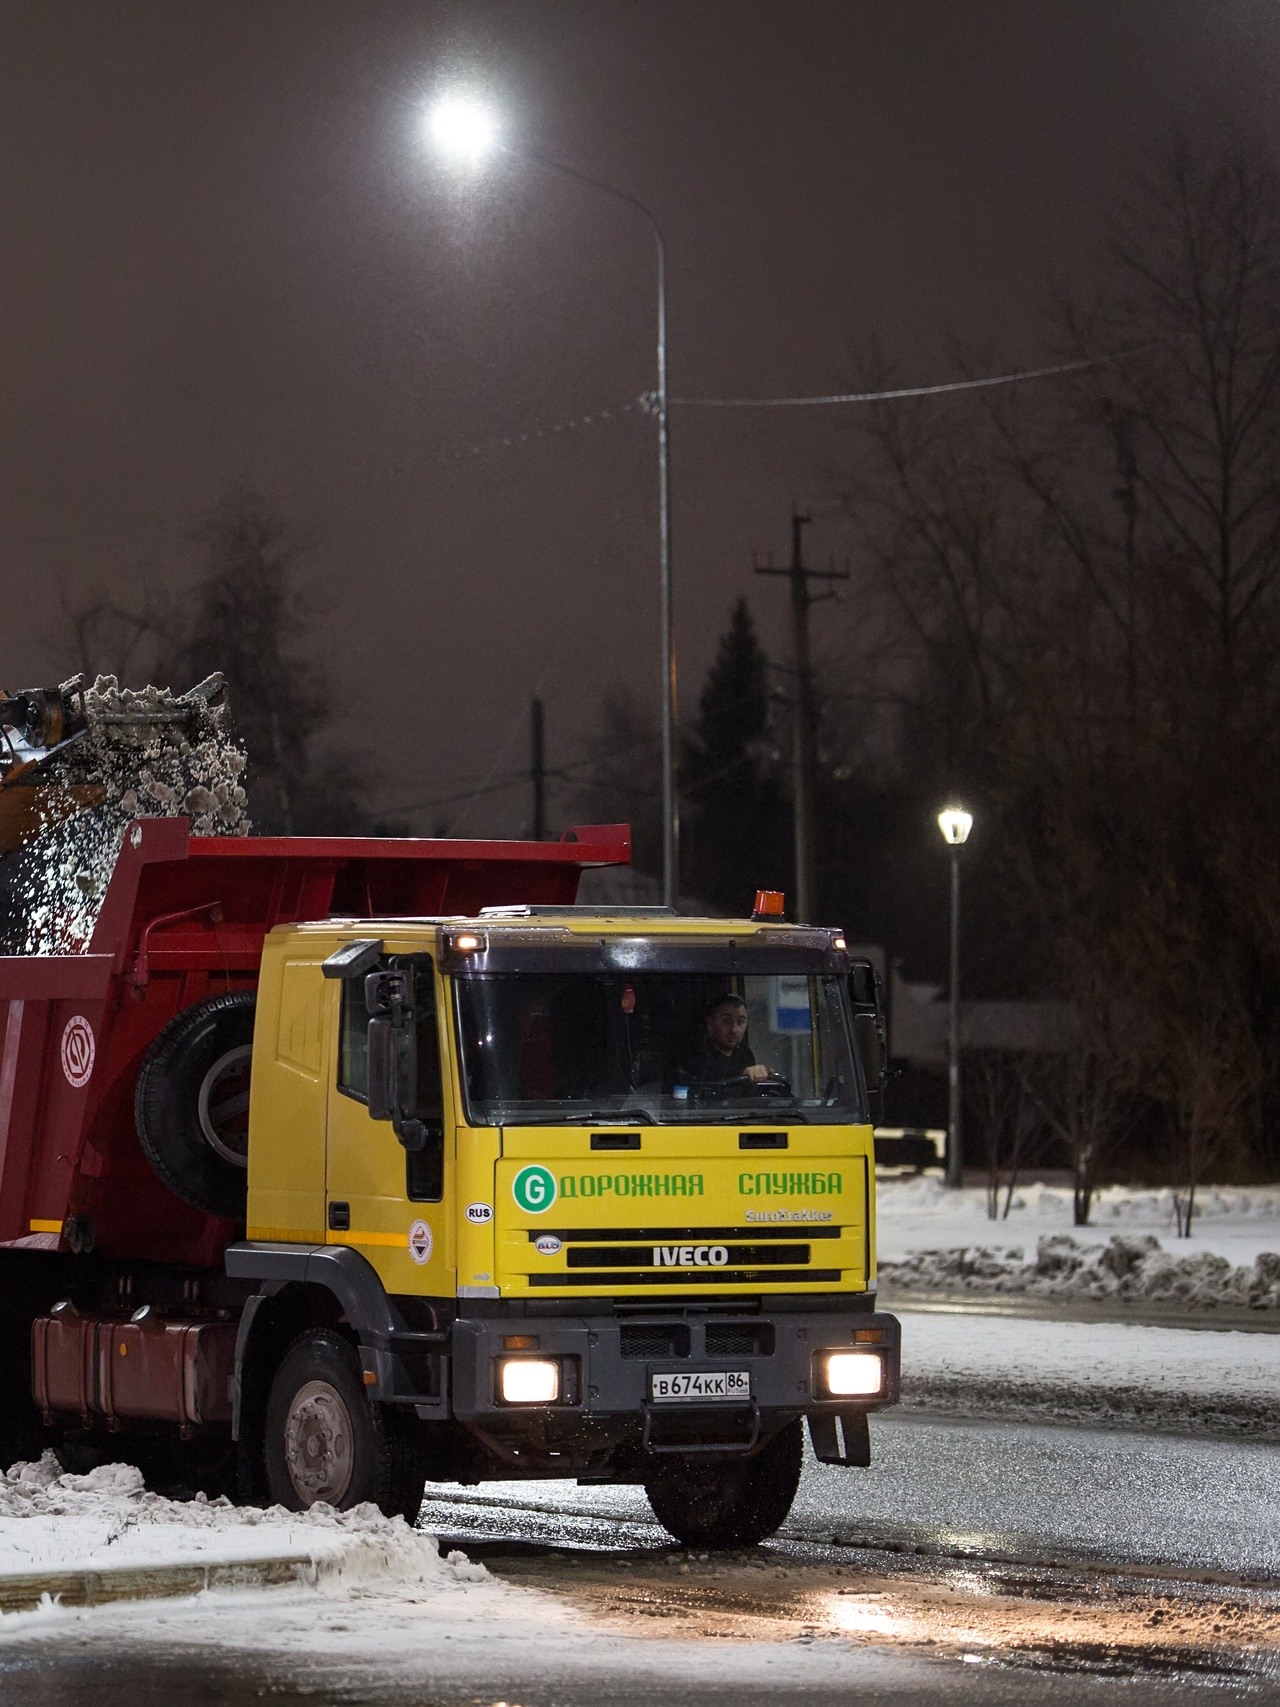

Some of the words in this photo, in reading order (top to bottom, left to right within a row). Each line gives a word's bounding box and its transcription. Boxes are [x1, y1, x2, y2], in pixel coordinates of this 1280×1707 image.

[525, 1174, 545, 1204] G
[559, 1174, 705, 1198] ДОРОЖНАЯ
[738, 1172, 842, 1196] СЛУЖБА
[468, 1208, 491, 1218] RUS
[745, 1209, 835, 1222] EuroTrakker
[653, 1246, 729, 1266] IVECO
[660, 1376, 724, 1395] В674КК
[728, 1374, 744, 1388] 86
